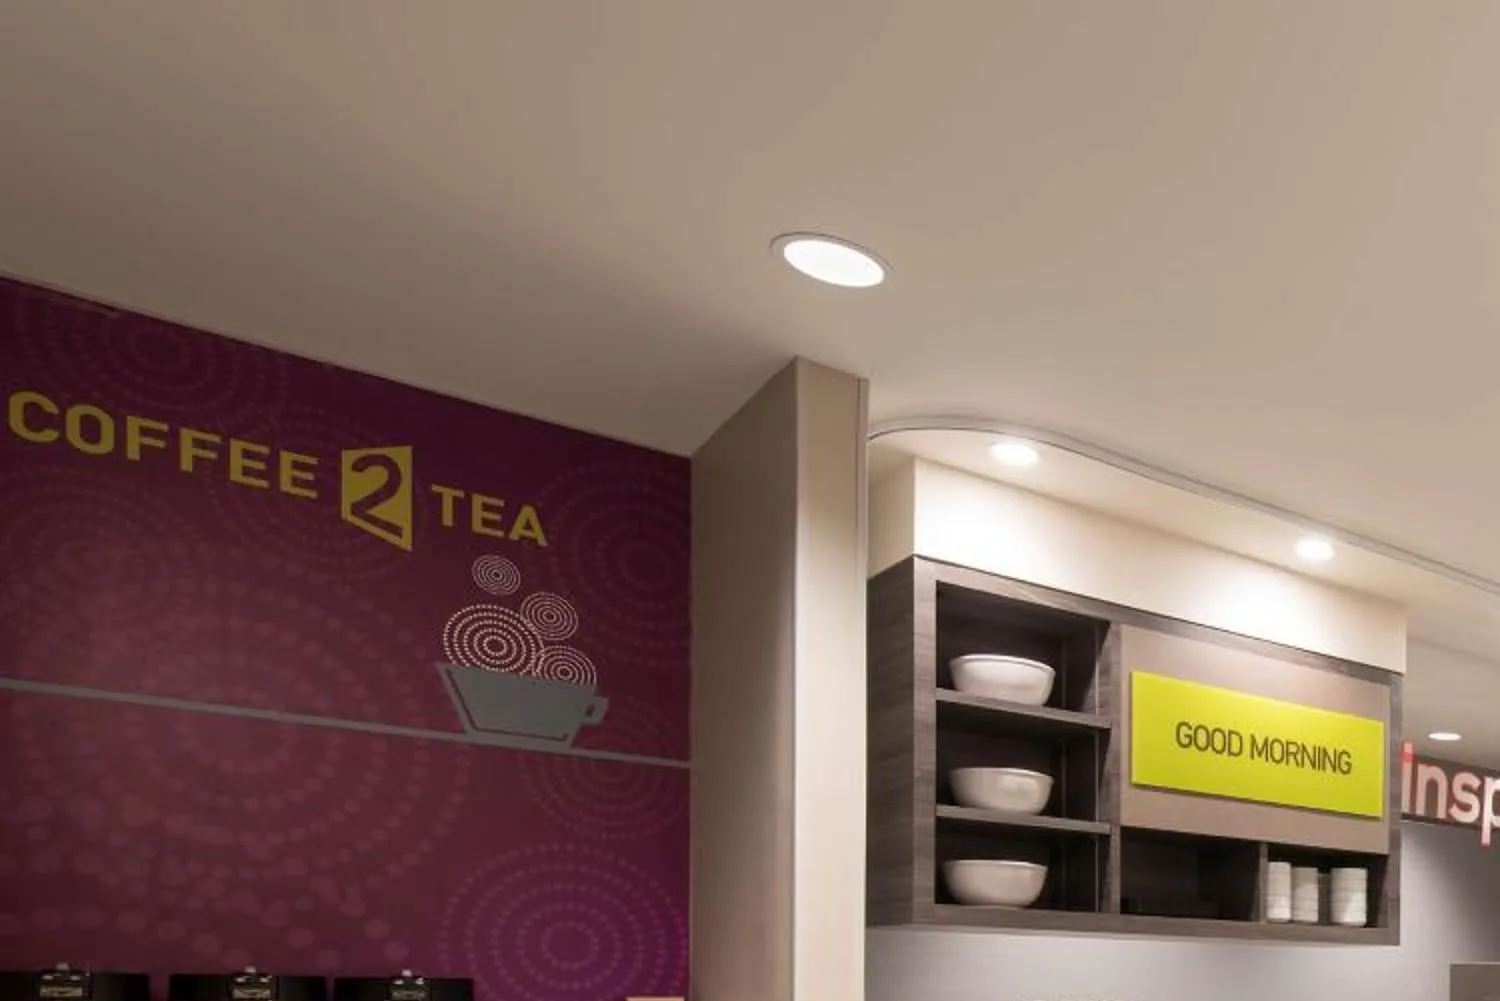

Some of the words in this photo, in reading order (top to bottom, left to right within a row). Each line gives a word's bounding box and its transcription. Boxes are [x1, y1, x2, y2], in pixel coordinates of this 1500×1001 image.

[8, 390, 319, 499] COFFEE
[347, 450, 408, 541] 2
[431, 484, 548, 548] TEA
[1175, 720, 1244, 757] GOOD
[1249, 737, 1353, 776] MORNING
